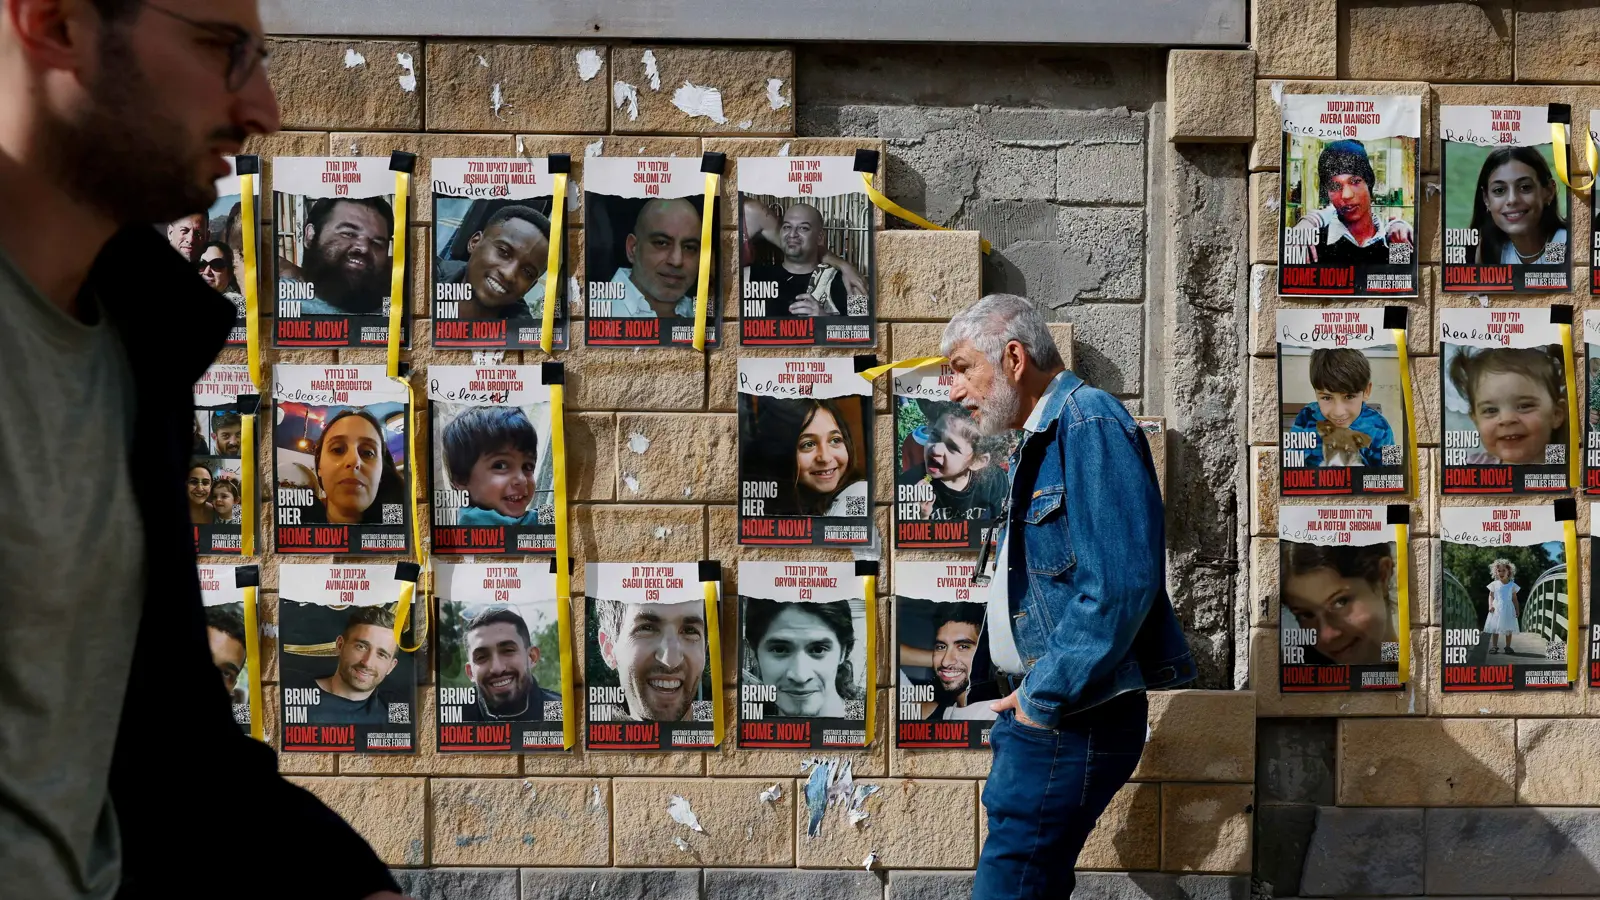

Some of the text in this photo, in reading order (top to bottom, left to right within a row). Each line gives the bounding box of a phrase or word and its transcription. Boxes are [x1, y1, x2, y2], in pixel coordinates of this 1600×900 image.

[1327, 101, 1374, 112] אברה מנגיסטו
[1320, 114, 1380, 124] AVERA MANGISTO
[1491, 122, 1520, 132] ALMA OR
[1283, 120, 1342, 138] Since 2014
[1342, 125, 1357, 137] (36)
[326, 161, 358, 172] איתן הורן
[322, 173, 362, 183] EITAN HORN
[463, 174, 536, 184] JOSHUA LOITU MOLLEL
[634, 172, 672, 184] SHLOMI ZIV
[788, 172, 822, 182] IAIR HORN
[334, 184, 348, 196] (37)
[645, 184, 660, 196] (40)
[798, 183, 812, 194] (45)
[1284, 226, 1320, 246] BRING
[1445, 228, 1479, 246] BRING
[1284, 246, 1307, 264] HIM
[1445, 246, 1467, 264] HER
[1283, 266, 1354, 286] HOME NOW!
[1445, 264, 1513, 284] HOME NOW!
[278, 282, 315, 300] BRING
[436, 282, 472, 301] BRING
[589, 281, 626, 300] BRING
[743, 280, 779, 299] BRING
[1366, 280, 1412, 290] FAMILIES FORUM
[278, 301, 301, 318] HIM
[436, 302, 458, 319] HIM
[589, 300, 612, 318] HIM
[743, 300, 766, 318] HIM
[278, 319, 348, 339] HOME NOW!
[436, 320, 506, 340] HOME NOW!
[589, 318, 659, 338] HOME NOW!
[744, 317, 814, 337] HOME NOW!
[826, 330, 870, 339] FAMILIES FORUM
[1334, 324, 1368, 334] YAHALOMI
[1486, 324, 1524, 334] YULY CUNIO
[1501, 334, 1510, 346] (3)
[310, 380, 372, 391] HAGAR BRODUTCH
[469, 381, 524, 392] ORIA BRODUTCH
[778, 374, 833, 384] OFRY BRODUTCH
[276, 382, 336, 404] Released
[334, 392, 348, 403] (40)
[1282, 432, 1316, 449] BRING
[1445, 430, 1480, 448] BRING
[1283, 450, 1305, 468] HIM
[1445, 448, 1468, 466] HER
[1283, 468, 1352, 488] HOME NOW!
[1444, 466, 1513, 486] HOME NOW!
[278, 488, 314, 507] BRING
[742, 480, 778, 498] BRING
[898, 484, 934, 502] BRING
[434, 490, 470, 508] BRING
[742, 500, 765, 516] HER
[278, 508, 302, 525] HER
[434, 508, 458, 526] HIM
[898, 502, 921, 520] HER
[1492, 509, 1521, 520] יהל שהם
[742, 517, 812, 537] HOME NOW!
[898, 523, 932, 540] HOME
[934, 520, 968, 540] NOW!
[1307, 520, 1382, 531] HILA ROTEM SHOSHANI
[1482, 521, 1532, 532] YAHEL SHOHAM
[278, 526, 348, 546] HOME NOW!
[361, 540, 405, 548] FAMILIES FORUM
[434, 526, 505, 546] HOME NOW!
[1338, 532, 1351, 544] (13)
[1502, 532, 1512, 544] (3)
[808, 566, 828, 576] אוריון
[325, 580, 370, 590] AVINATAN OR
[482, 578, 522, 589] ORI DANINO
[622, 578, 684, 588] SAGUI DEKEL CHEN
[774, 577, 838, 588] ORYON HERNANDEZ
[936, 578, 967, 588] EVYATAR
[340, 591, 354, 602] (30)
[494, 590, 509, 602] (24)
[646, 590, 660, 601] (35)
[799, 588, 812, 600] (21)
[956, 588, 970, 600] (23)
[1283, 628, 1317, 646] BRING
[1445, 628, 1480, 646] BRING
[1283, 646, 1305, 664] HER
[1445, 646, 1467, 664] HER
[1283, 664, 1350, 684] HOME NOW!
[1445, 664, 1513, 684] HOME NOW!
[284, 688, 320, 706] BRING
[440, 687, 476, 704] BRING
[589, 686, 625, 704] BRING
[741, 684, 777, 702] BRING
[900, 684, 935, 702] BRING
[285, 706, 308, 724] HIM
[440, 706, 463, 723] HIM
[589, 704, 612, 722] HIM
[741, 702, 764, 720] HIM
[900, 702, 922, 720] HIM
[285, 724, 356, 744] HOME NOW!
[440, 724, 511, 744] HOME NOW!
[589, 722, 659, 742] HOME NOW!
[741, 721, 810, 741] HOME NOW!
[900, 722, 932, 740] HOME
[934, 720, 969, 740] NOW!
